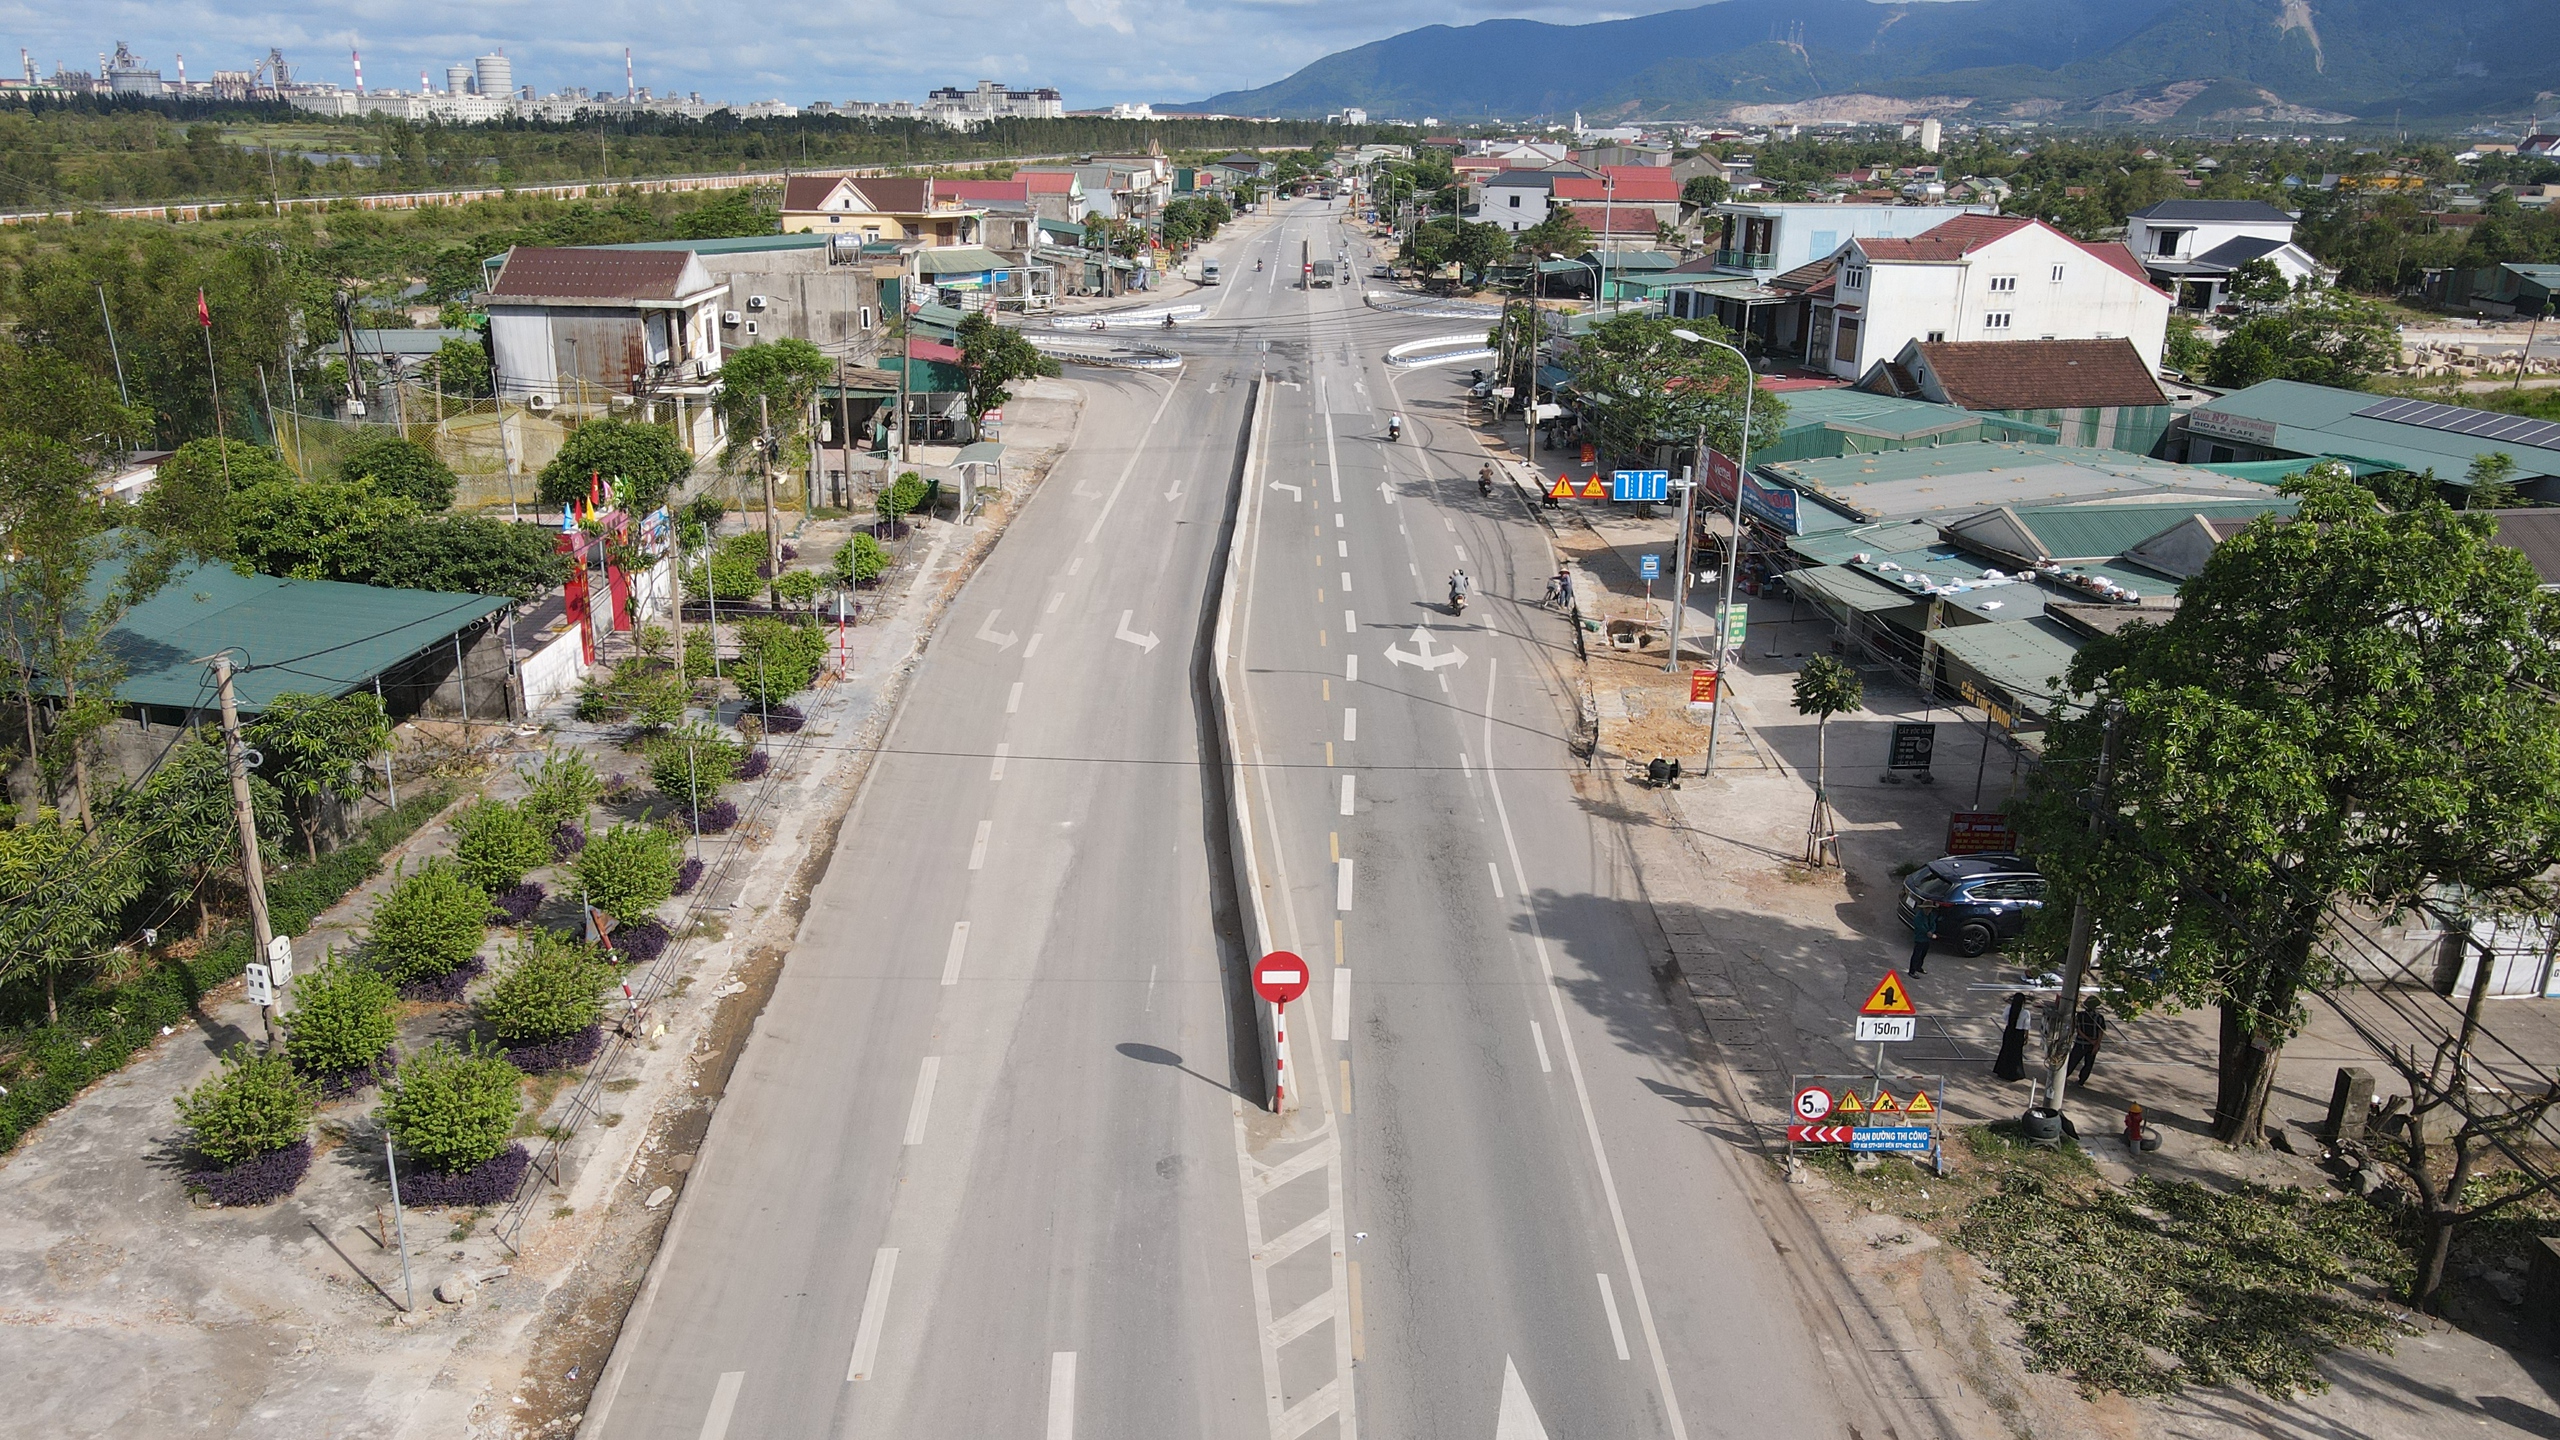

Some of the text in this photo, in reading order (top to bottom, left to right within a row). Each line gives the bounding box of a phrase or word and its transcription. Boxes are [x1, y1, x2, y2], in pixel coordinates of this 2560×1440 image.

[2194, 421, 2217, 430] BIDA
[2230, 428, 2255, 437] CAFE
[1873, 1022, 1900, 1036] 150m
[1802, 1095, 1814, 1114] 5
[1897, 1132, 1908, 1141] THI
[1908, 1130, 1928, 1141] CÔNG
